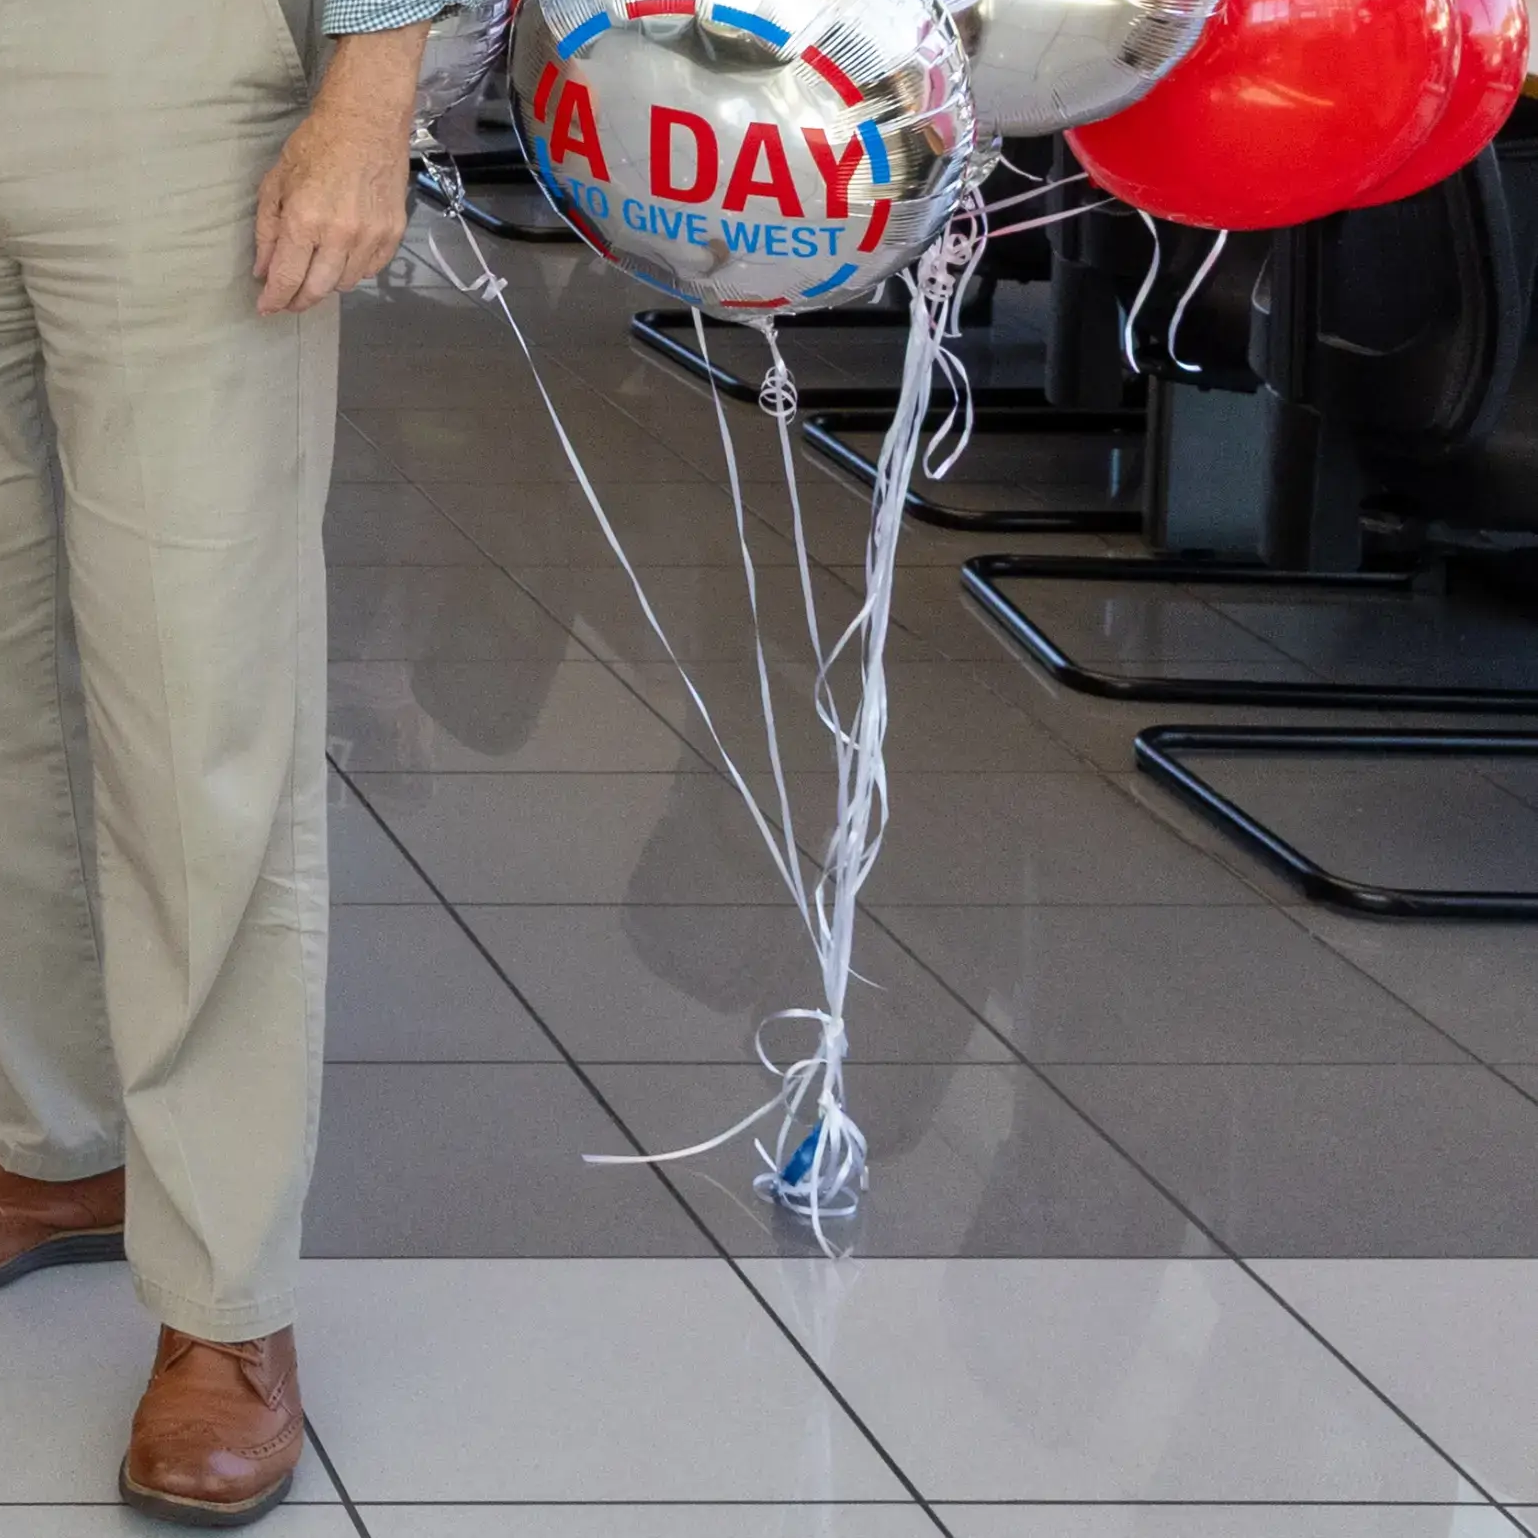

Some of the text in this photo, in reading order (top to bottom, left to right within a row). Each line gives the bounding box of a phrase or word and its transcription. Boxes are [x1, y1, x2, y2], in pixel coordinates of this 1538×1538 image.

[549, 78, 865, 220] A DAY
[565, 175, 847, 260] TO GIVE WEST
